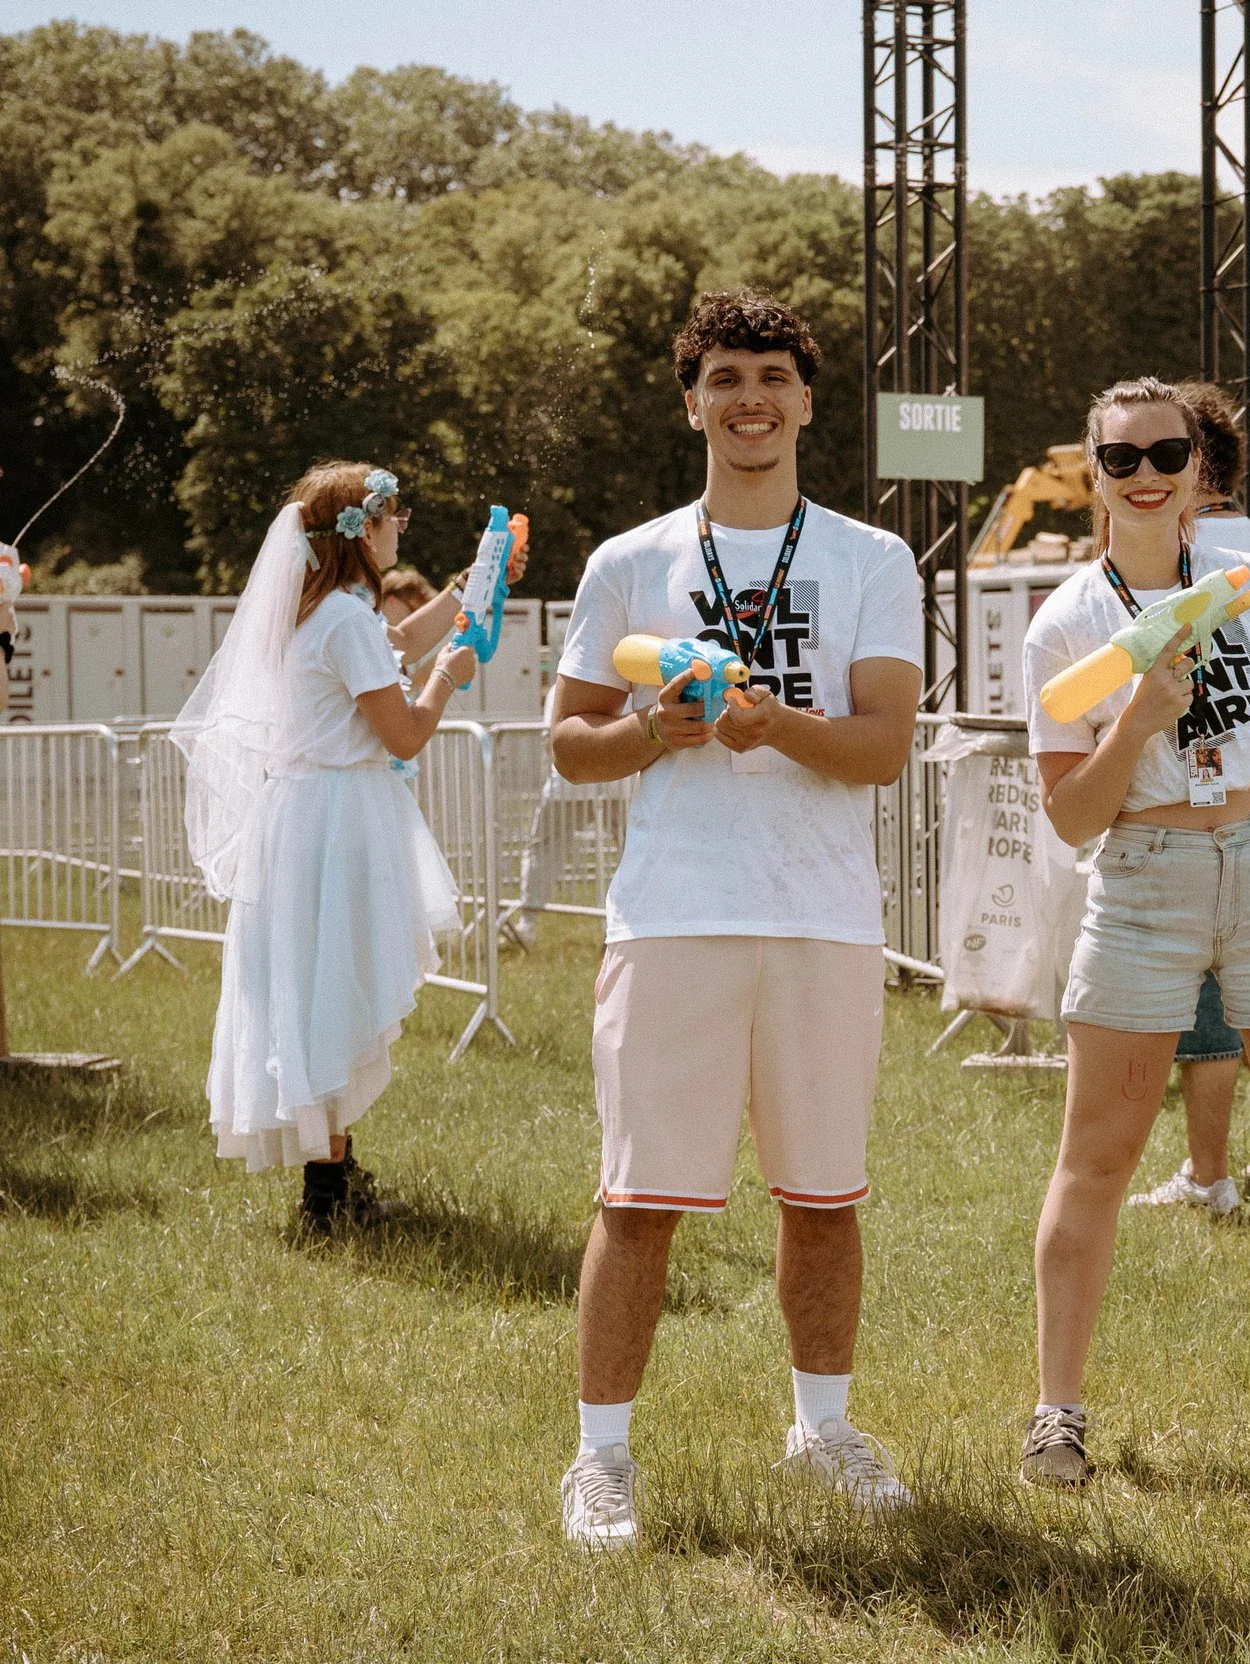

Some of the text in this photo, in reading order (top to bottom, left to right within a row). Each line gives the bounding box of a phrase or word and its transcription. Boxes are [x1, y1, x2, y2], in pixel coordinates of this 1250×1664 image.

[899, 402, 962, 432] SORTIE
[734, 600, 761, 612] Solidar
[987, 608, 1002, 715] ILETS
[981, 912, 1022, 928] PARIS
